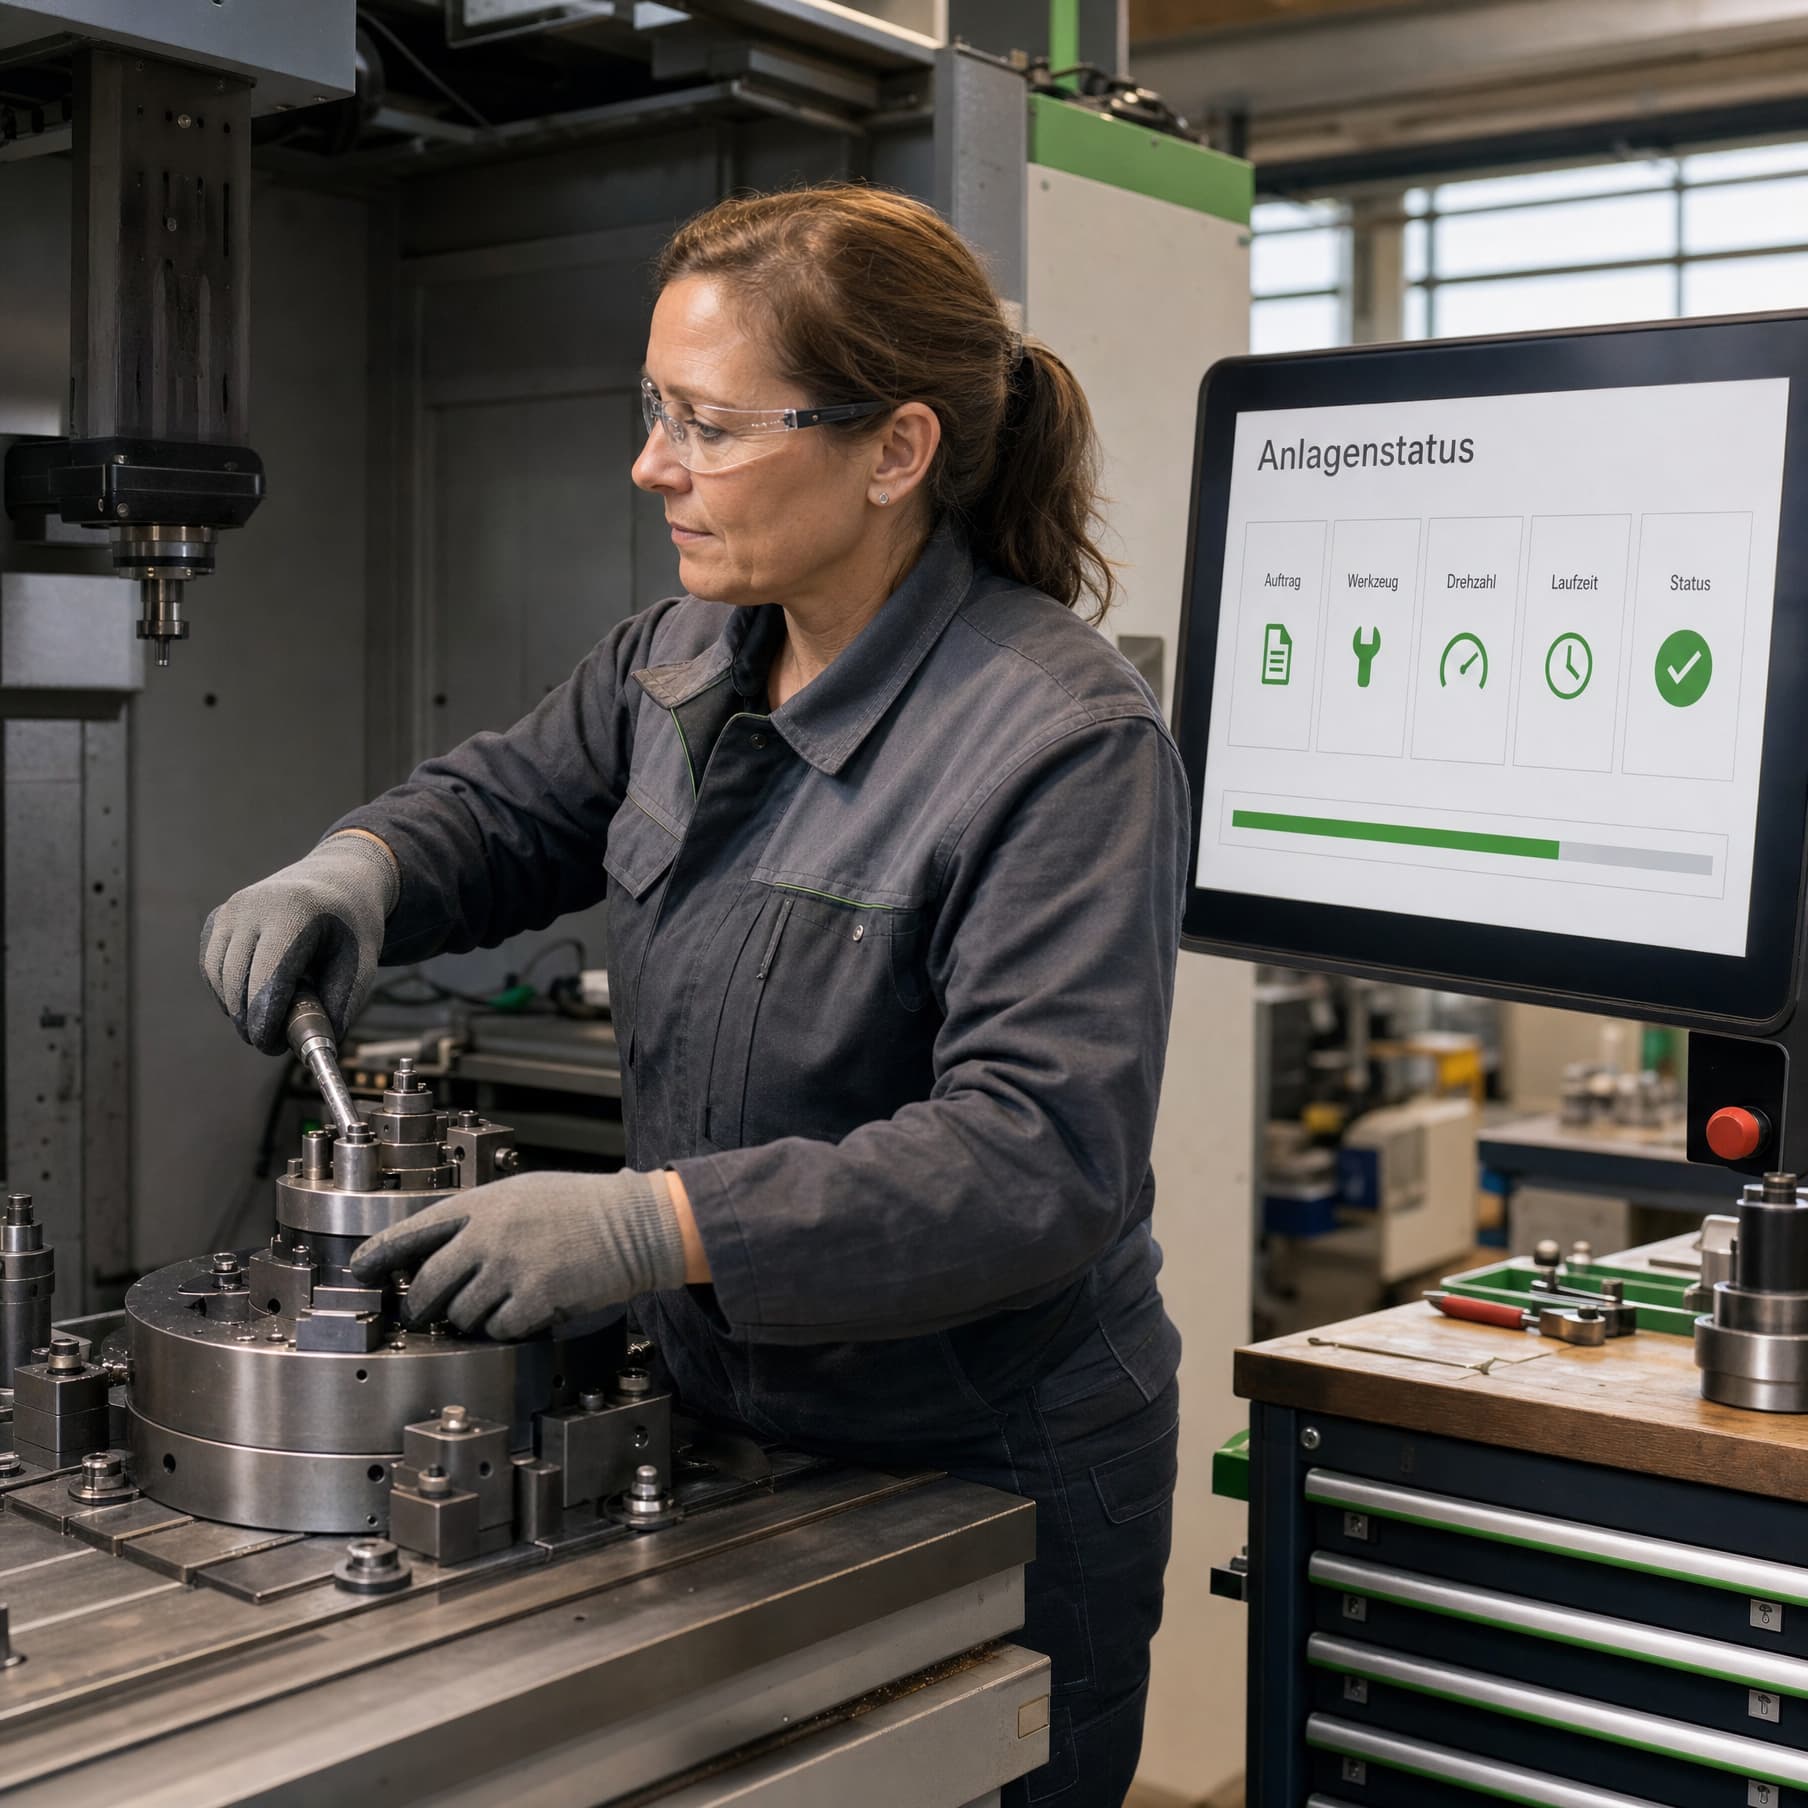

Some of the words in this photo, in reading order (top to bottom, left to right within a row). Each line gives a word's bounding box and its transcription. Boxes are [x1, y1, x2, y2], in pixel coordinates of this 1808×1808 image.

[1257, 434, 1474, 477] Anlagenstatus
[1264, 573, 1301, 591] Auftrag
[1347, 573, 1399, 592] Werkzeug
[1447, 573, 1497, 590] Drehzahl
[1551, 574, 1599, 591] Laufzeit
[1670, 574, 1711, 591] Status
